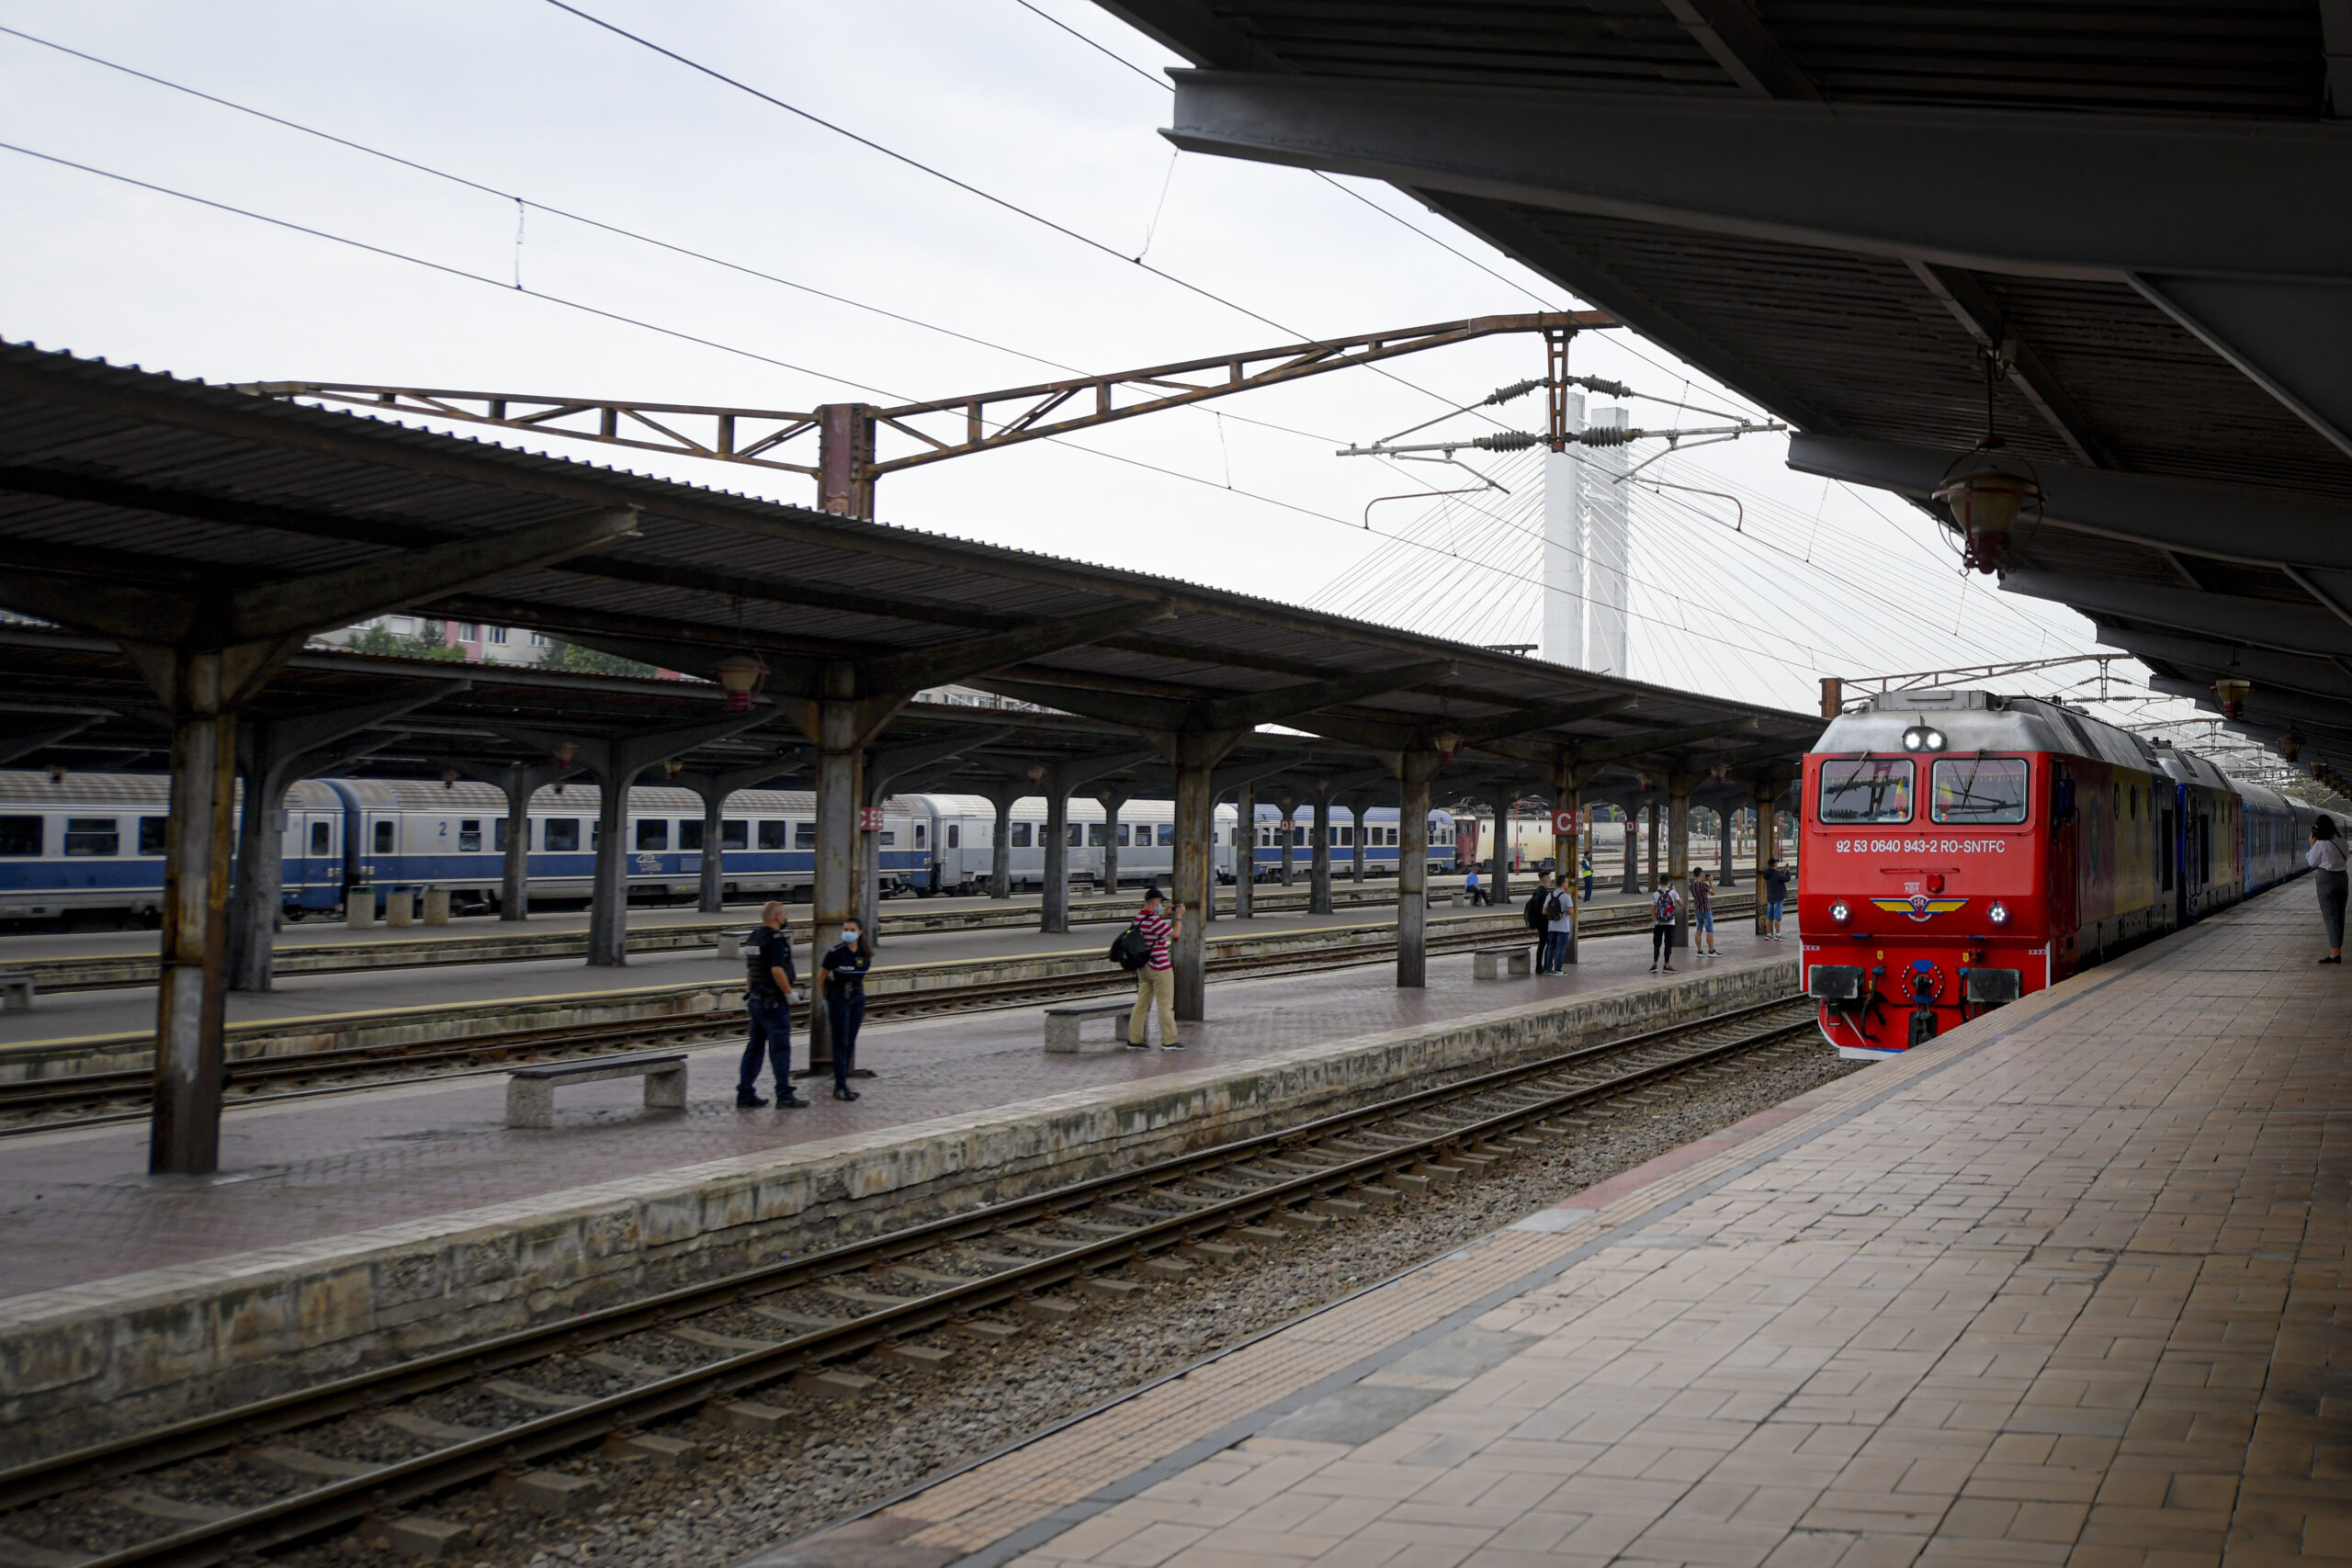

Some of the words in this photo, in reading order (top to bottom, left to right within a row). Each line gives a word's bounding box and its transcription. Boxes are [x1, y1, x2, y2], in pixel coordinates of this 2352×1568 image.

[1556, 812, 1572, 831] C
[1626, 822, 1634, 831] D
[438, 821, 447, 837] 2
[1836, 840, 1850, 853] 92
[1853, 840, 1868, 853] 53
[1871, 840, 1901, 853] 0640
[1904, 840, 1938, 853] 943-2
[1940, 840, 2006, 853] RO-SNTFC
